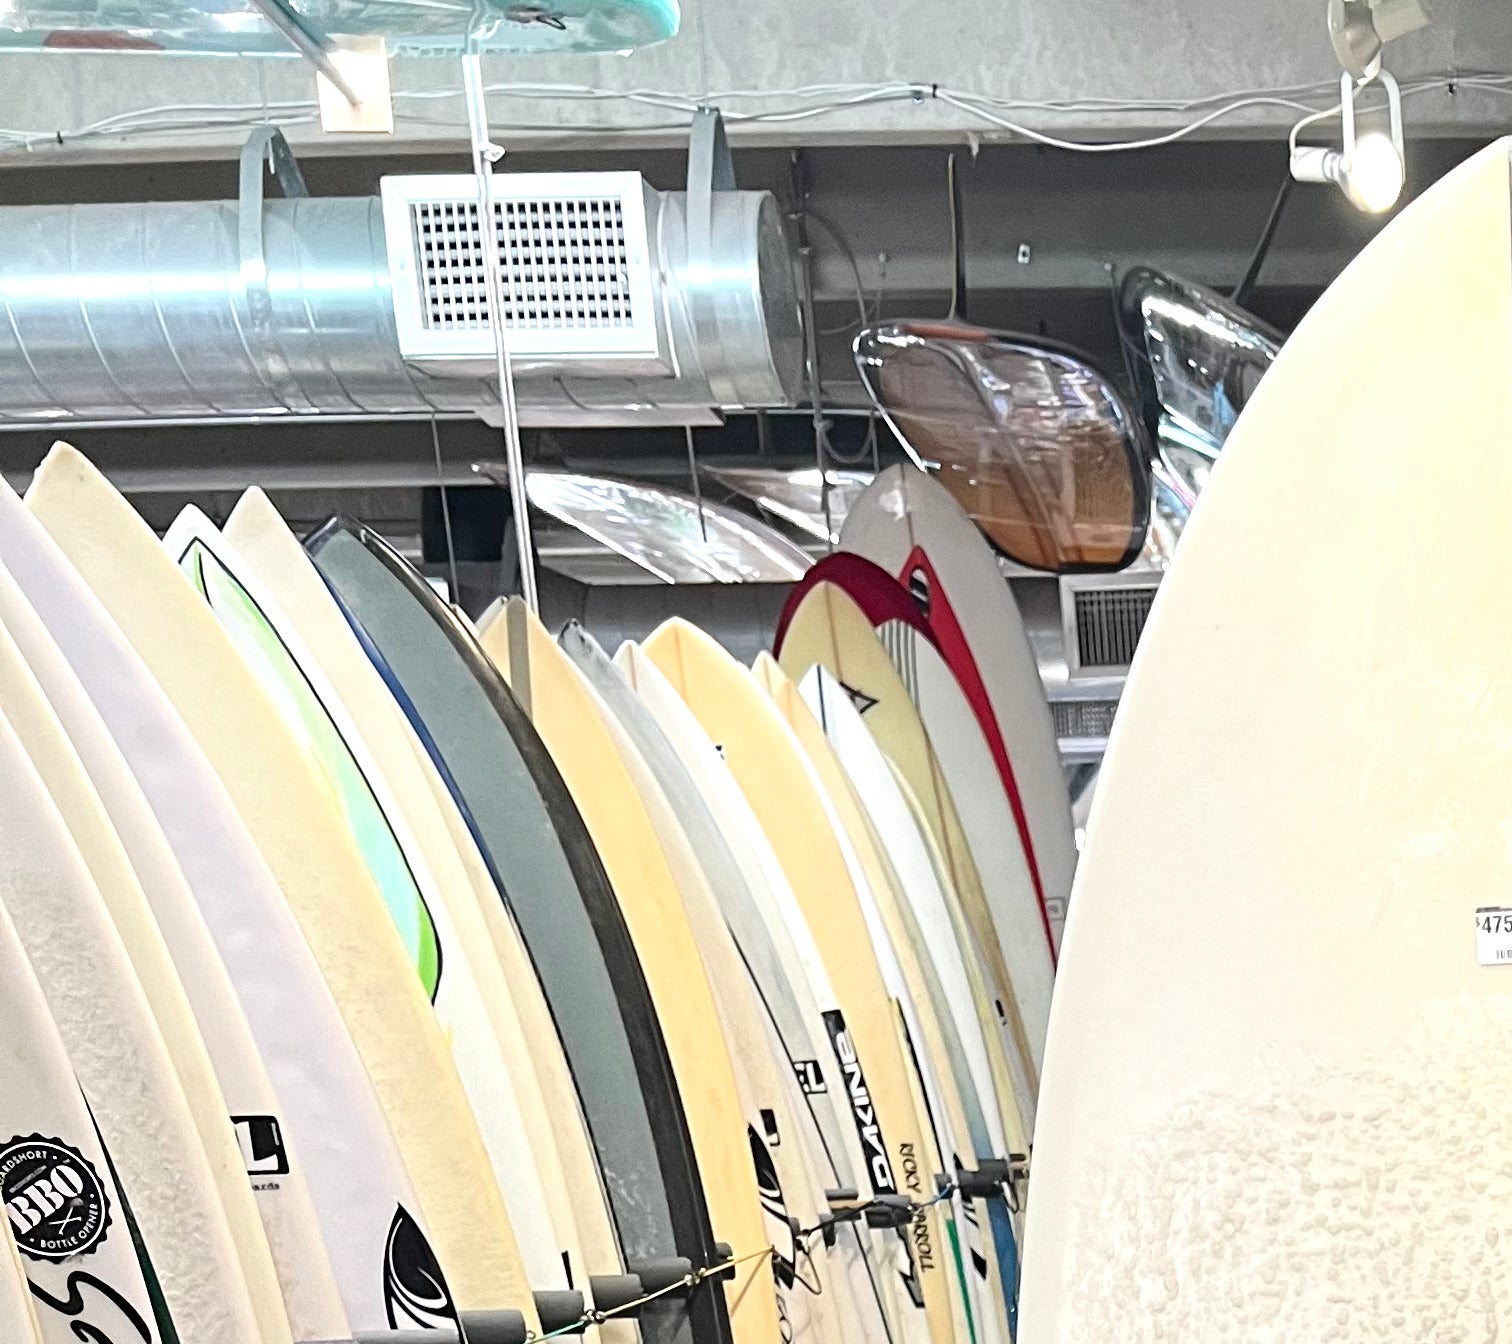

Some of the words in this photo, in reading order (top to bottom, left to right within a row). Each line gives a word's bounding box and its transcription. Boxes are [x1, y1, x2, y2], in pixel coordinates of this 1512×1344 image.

[6, 1165, 84, 1235] BBO
[40, 1236, 79, 1249] BOTTLE
[78, 1203, 99, 1239] OPENER
[900, 1142, 922, 1195] RICKY
[913, 1204, 935, 1274] ARROLL
